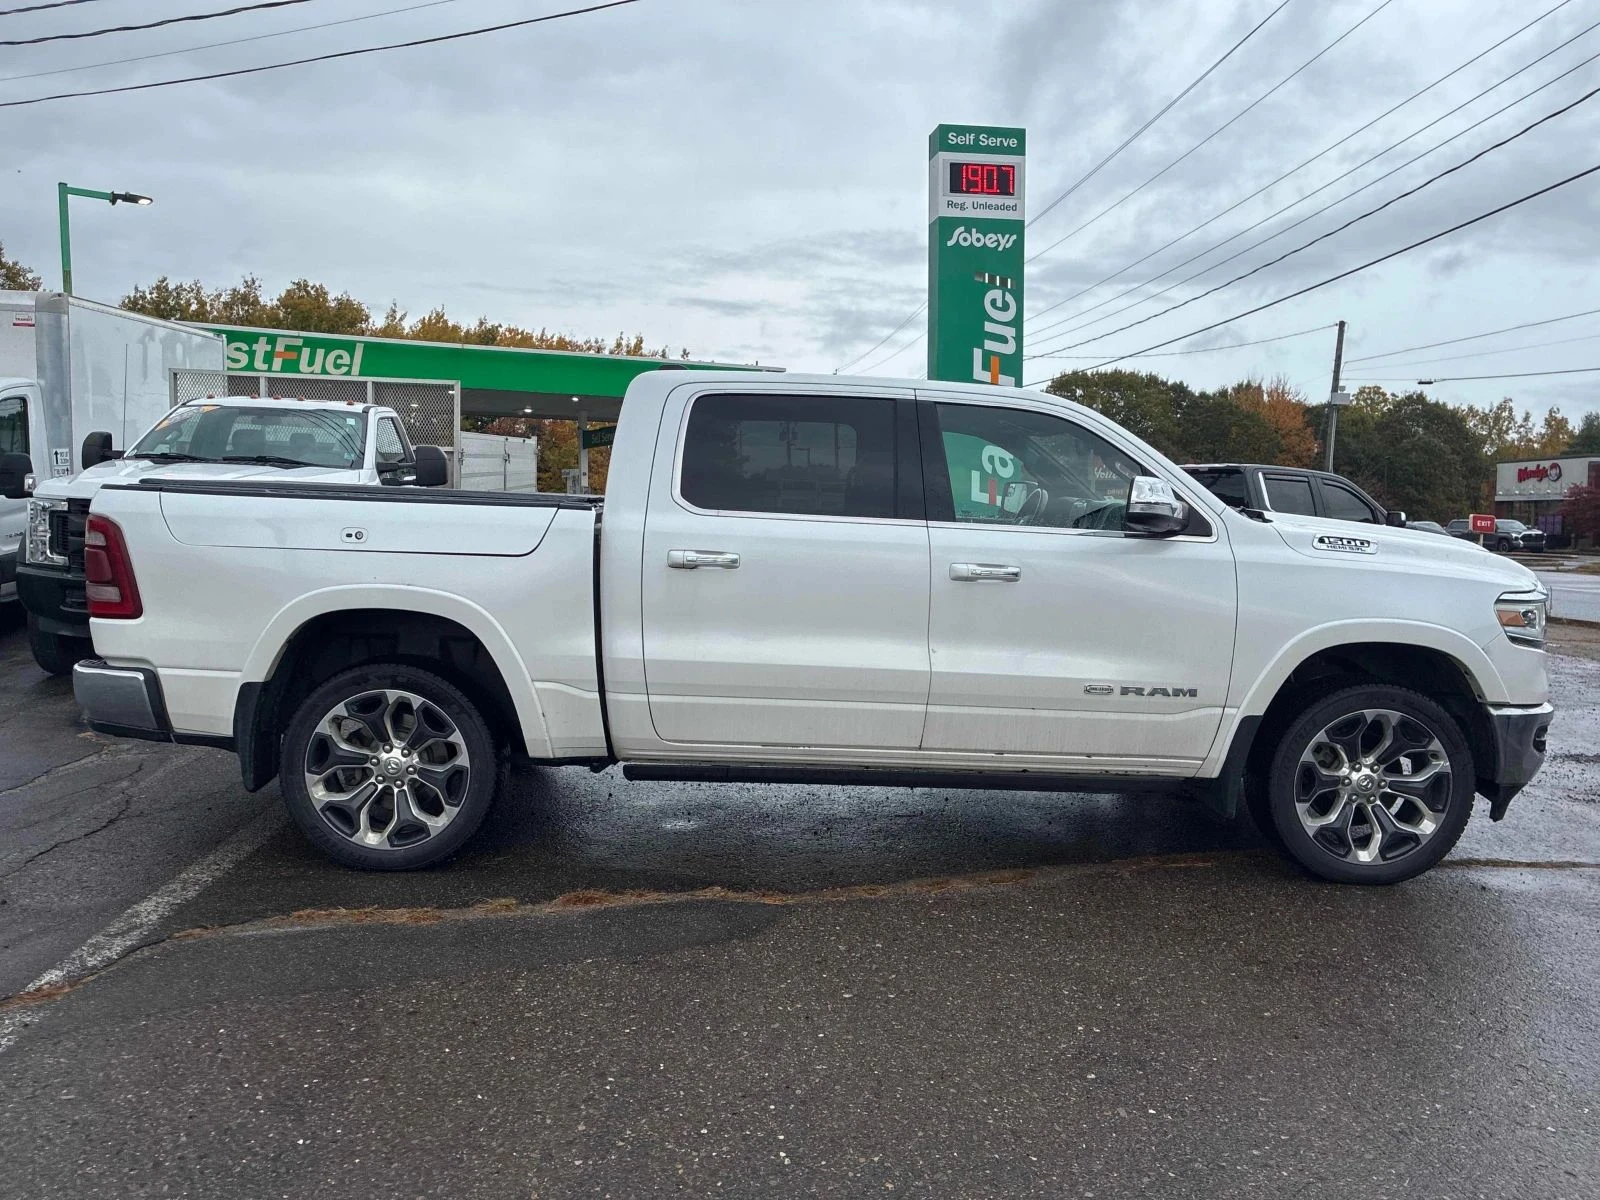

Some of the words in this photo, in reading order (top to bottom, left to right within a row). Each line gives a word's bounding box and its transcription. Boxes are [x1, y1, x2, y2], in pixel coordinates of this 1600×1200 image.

[948, 132, 975, 145] Self
[979, 134, 1018, 147] Serve
[947, 200, 969, 211] Reg.
[972, 201, 1018, 212] Unleaded
[946, 226, 1017, 251] Sobeys
[1120, 686, 1198, 697] RAM
